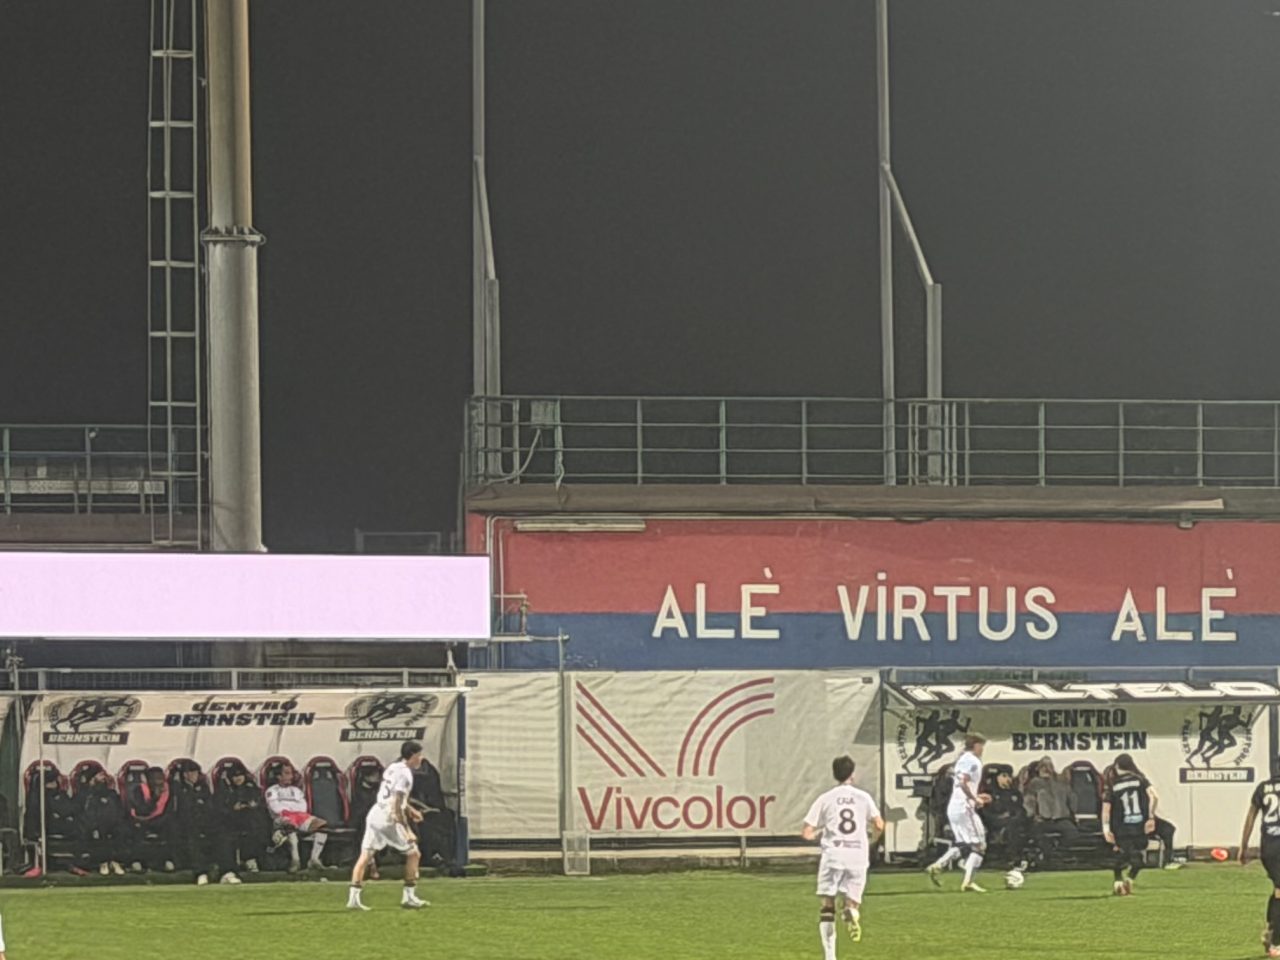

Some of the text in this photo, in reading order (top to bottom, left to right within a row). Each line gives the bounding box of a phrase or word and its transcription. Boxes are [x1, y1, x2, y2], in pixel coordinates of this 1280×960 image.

[652, 567, 780, 639] ALÈ
[1111, 568, 1237, 641] ALÈ
[192, 701, 298, 713] CENTRO
[163, 712, 316, 727] BERNSTEIN
[1032, 708, 1127, 728] CENTRO
[48, 733, 121, 744] BERNSTEIN
[348, 729, 418, 740] BERNSTEIN
[1012, 731, 1147, 751] BERNSTEIN
[577, 785, 776, 830] Vivcolor
[1120, 790, 1141, 816] 11
[838, 808, 857, 834] 8
